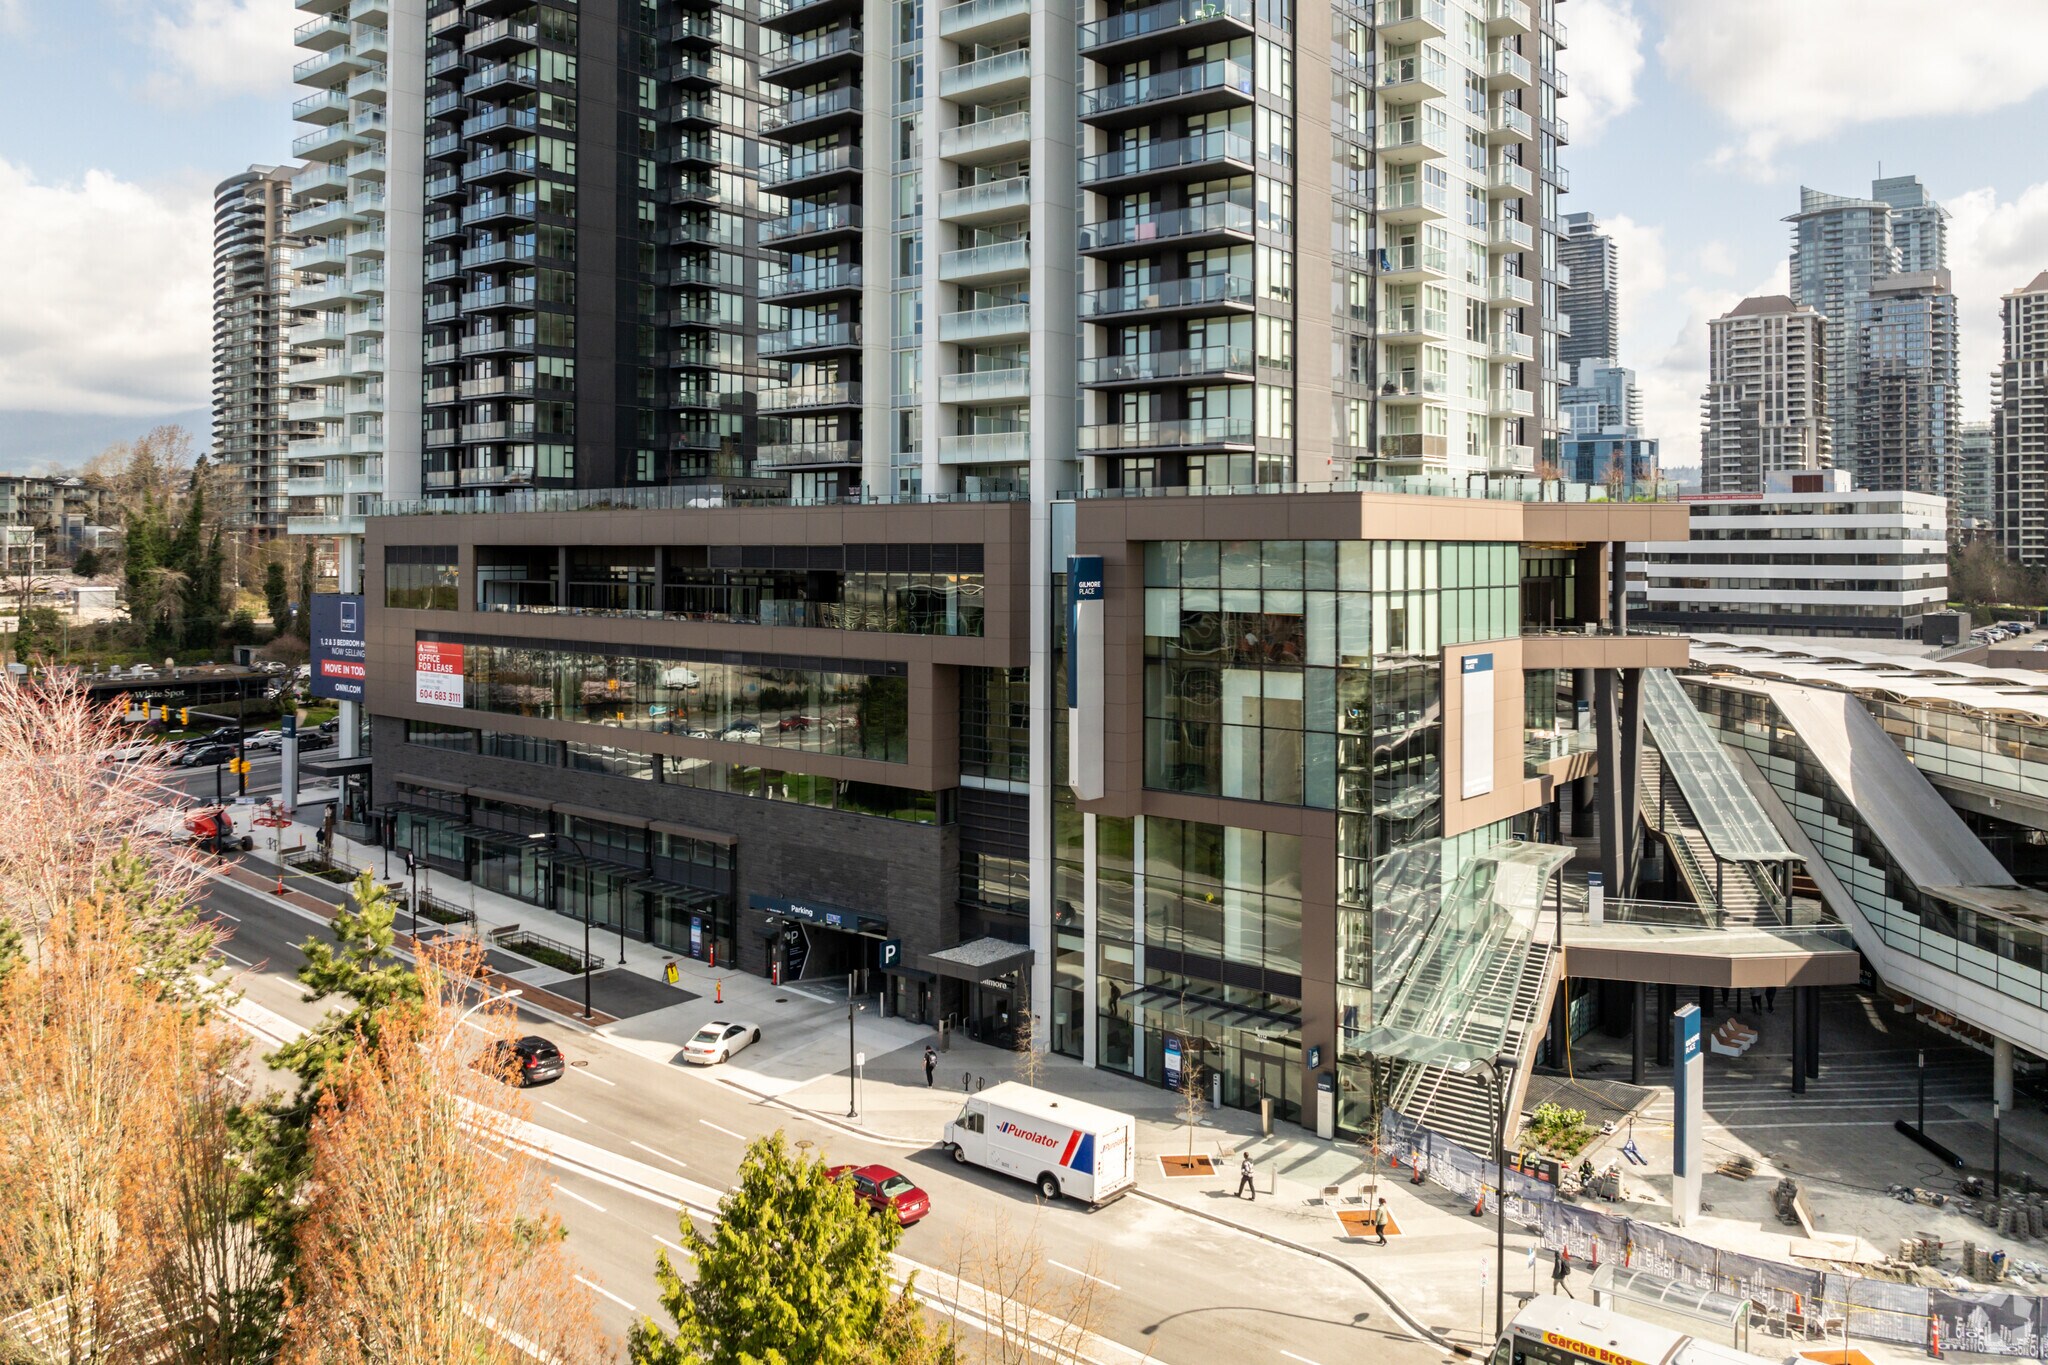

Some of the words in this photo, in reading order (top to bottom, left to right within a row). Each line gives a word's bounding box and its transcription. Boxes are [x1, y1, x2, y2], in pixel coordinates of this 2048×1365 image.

[337, 639, 360, 647] BEDROOM
[332, 647, 344, 655] NOW
[418, 653, 440, 663] OFFICE
[325, 663, 341, 673] MOVE
[343, 665, 350, 674] IN
[418, 662, 431, 670] FOR
[433, 663, 453, 673] LEASE
[134, 689, 162, 698] White
[164, 688, 185, 698] Spot
[335, 684, 361, 693] ONNI.COM
[419, 689, 432, 698] 604
[434, 691, 446, 700] 683
[448, 692, 461, 702] 3111
[791, 904, 813, 917] Parking
[885, 944, 896, 964] P
[1008, 1124, 1059, 1148] Purolator
[1547, 1332, 1596, 1358] Garcha
